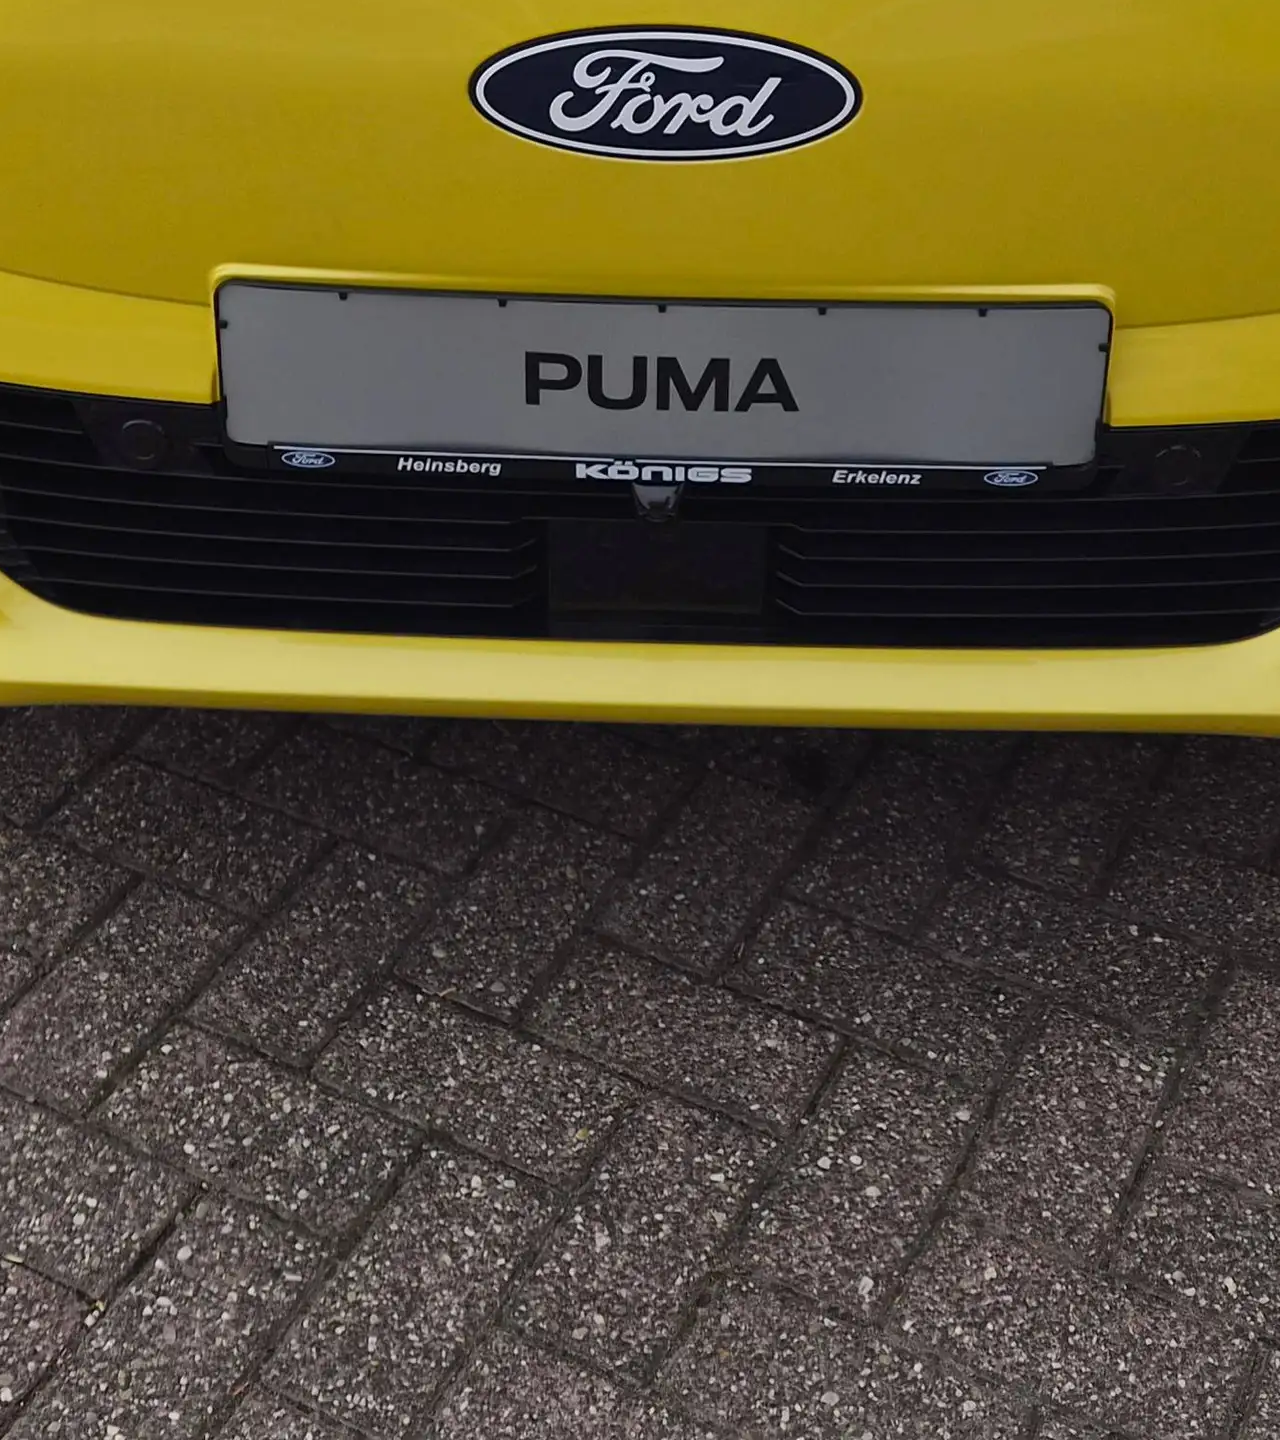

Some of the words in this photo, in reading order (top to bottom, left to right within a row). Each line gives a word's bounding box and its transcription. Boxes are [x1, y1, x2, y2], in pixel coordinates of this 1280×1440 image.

[549, 49, 782, 137] Ford
[524, 351, 800, 412] PUMA
[397, 456, 502, 476] Heinsberg
[575, 460, 752, 483] KÖNIGS
[832, 469, 922, 485] Erkelenz
